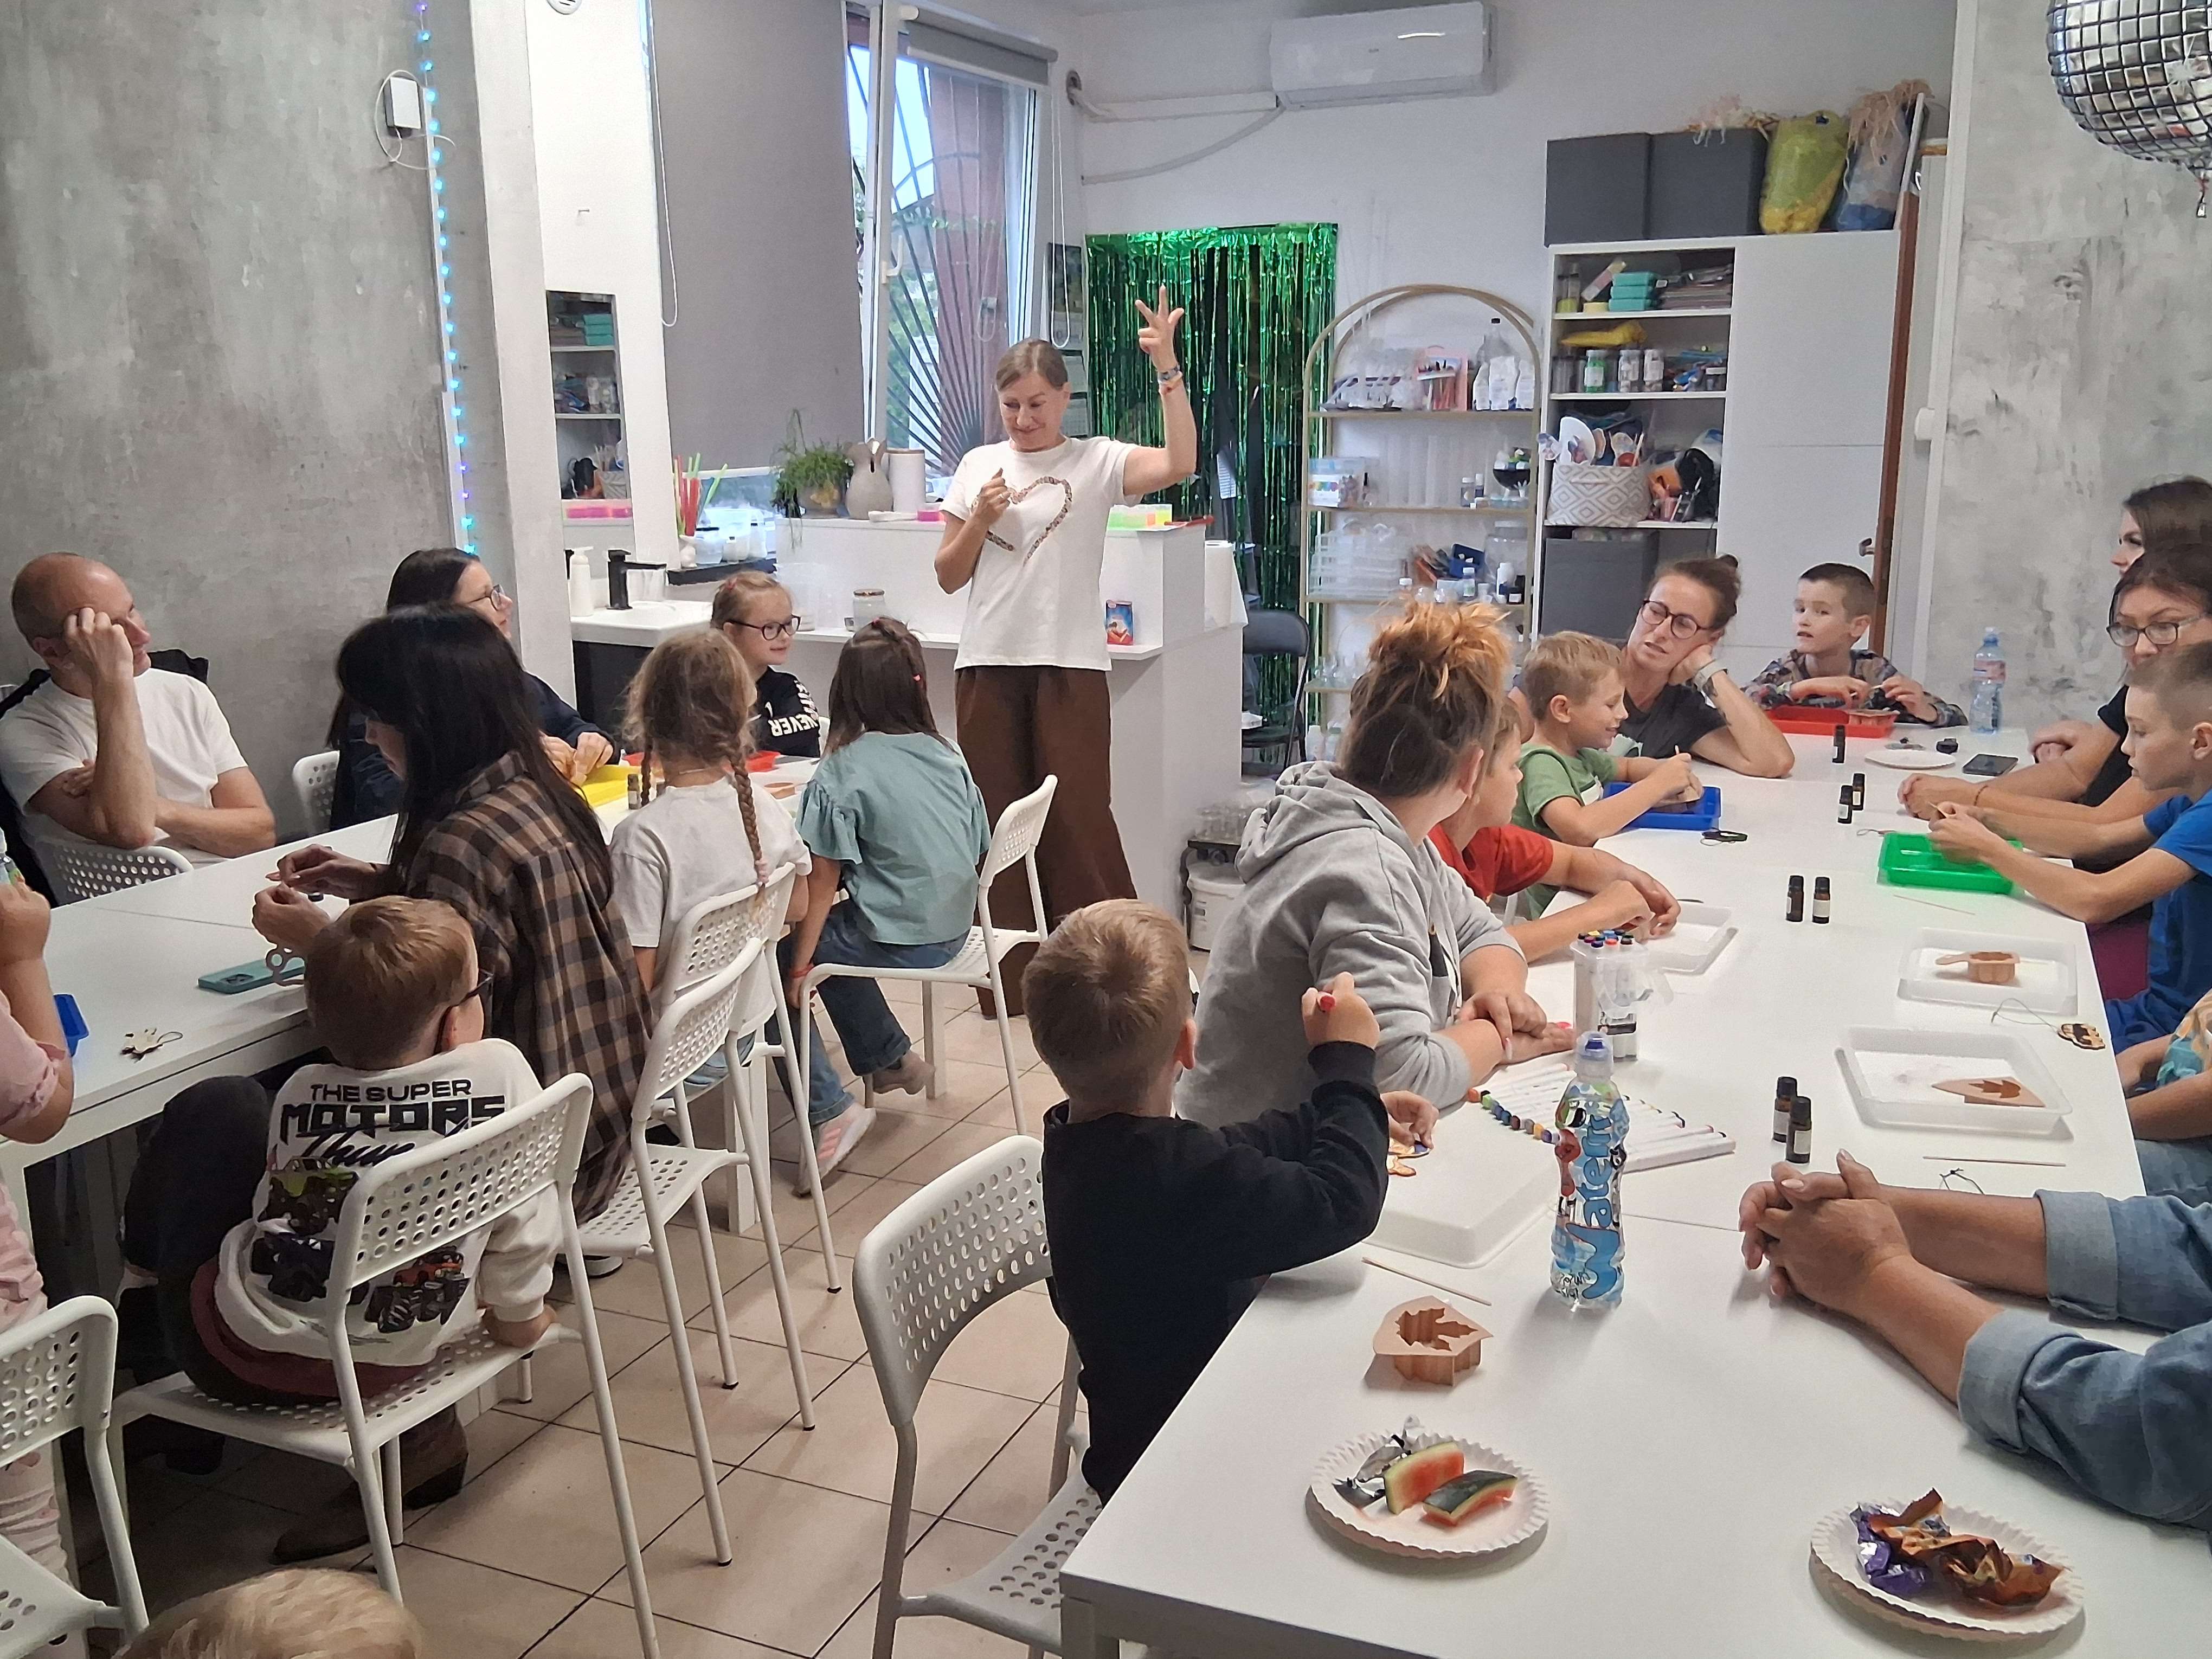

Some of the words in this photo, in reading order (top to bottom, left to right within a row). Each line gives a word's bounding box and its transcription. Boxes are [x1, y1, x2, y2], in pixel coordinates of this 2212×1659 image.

[767, 713, 819, 737] NEVER
[311, 1084, 361, 1103] THE
[366, 1079, 472, 1101] SUPER
[280, 1096, 505, 1146] MOTORS
